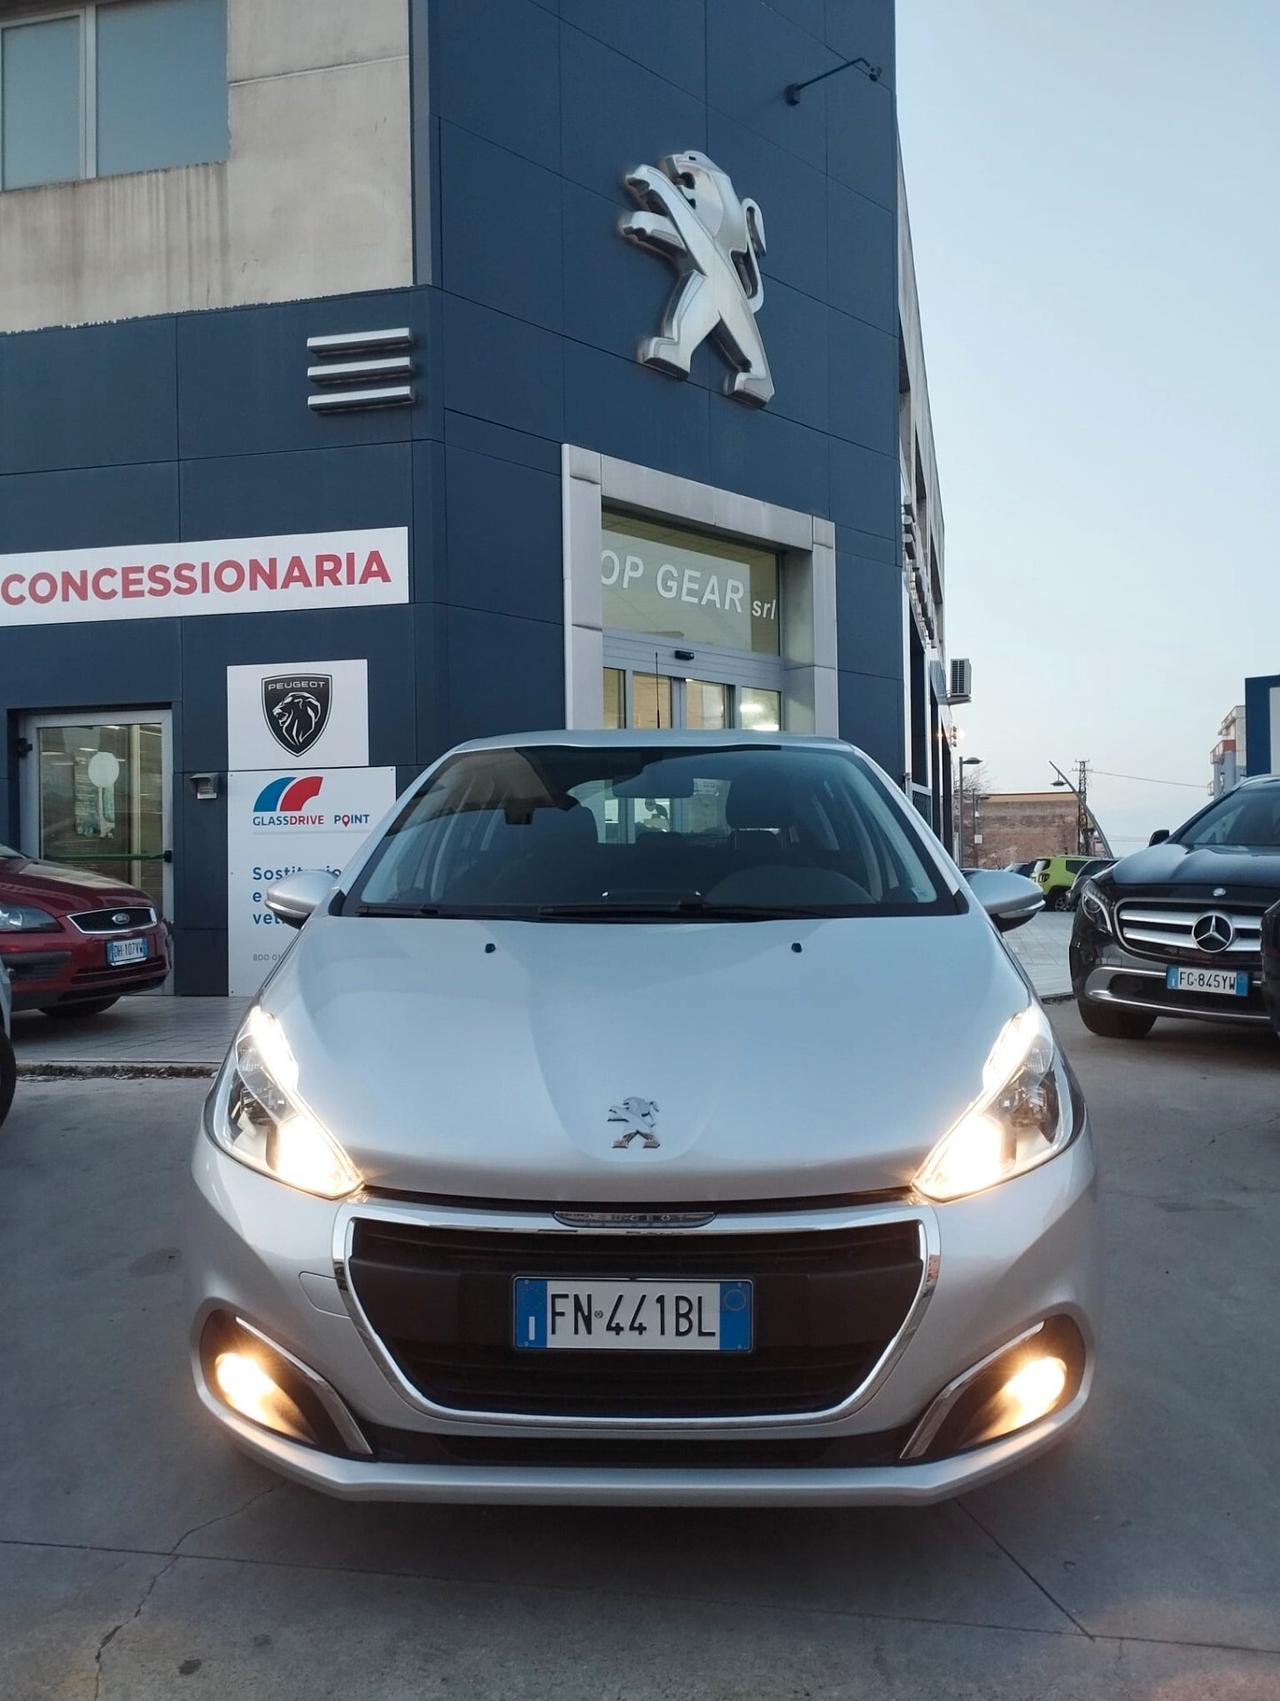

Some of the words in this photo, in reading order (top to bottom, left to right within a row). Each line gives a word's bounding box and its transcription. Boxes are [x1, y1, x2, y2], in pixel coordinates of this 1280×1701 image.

[1, 550, 392, 605] CONCESSIONARIA
[656, 564, 744, 613] GEAR
[752, 600, 776, 619] srl
[268, 681, 325, 691] PEUGEOT
[253, 814, 324, 826] GLASSDRIVE
[334, 814, 370, 827] POINT
[253, 891, 262, 902] e
[253, 953, 269, 961] 800
[551, 1293, 592, 1336] FN
[606, 1294, 716, 1337] 441BL
